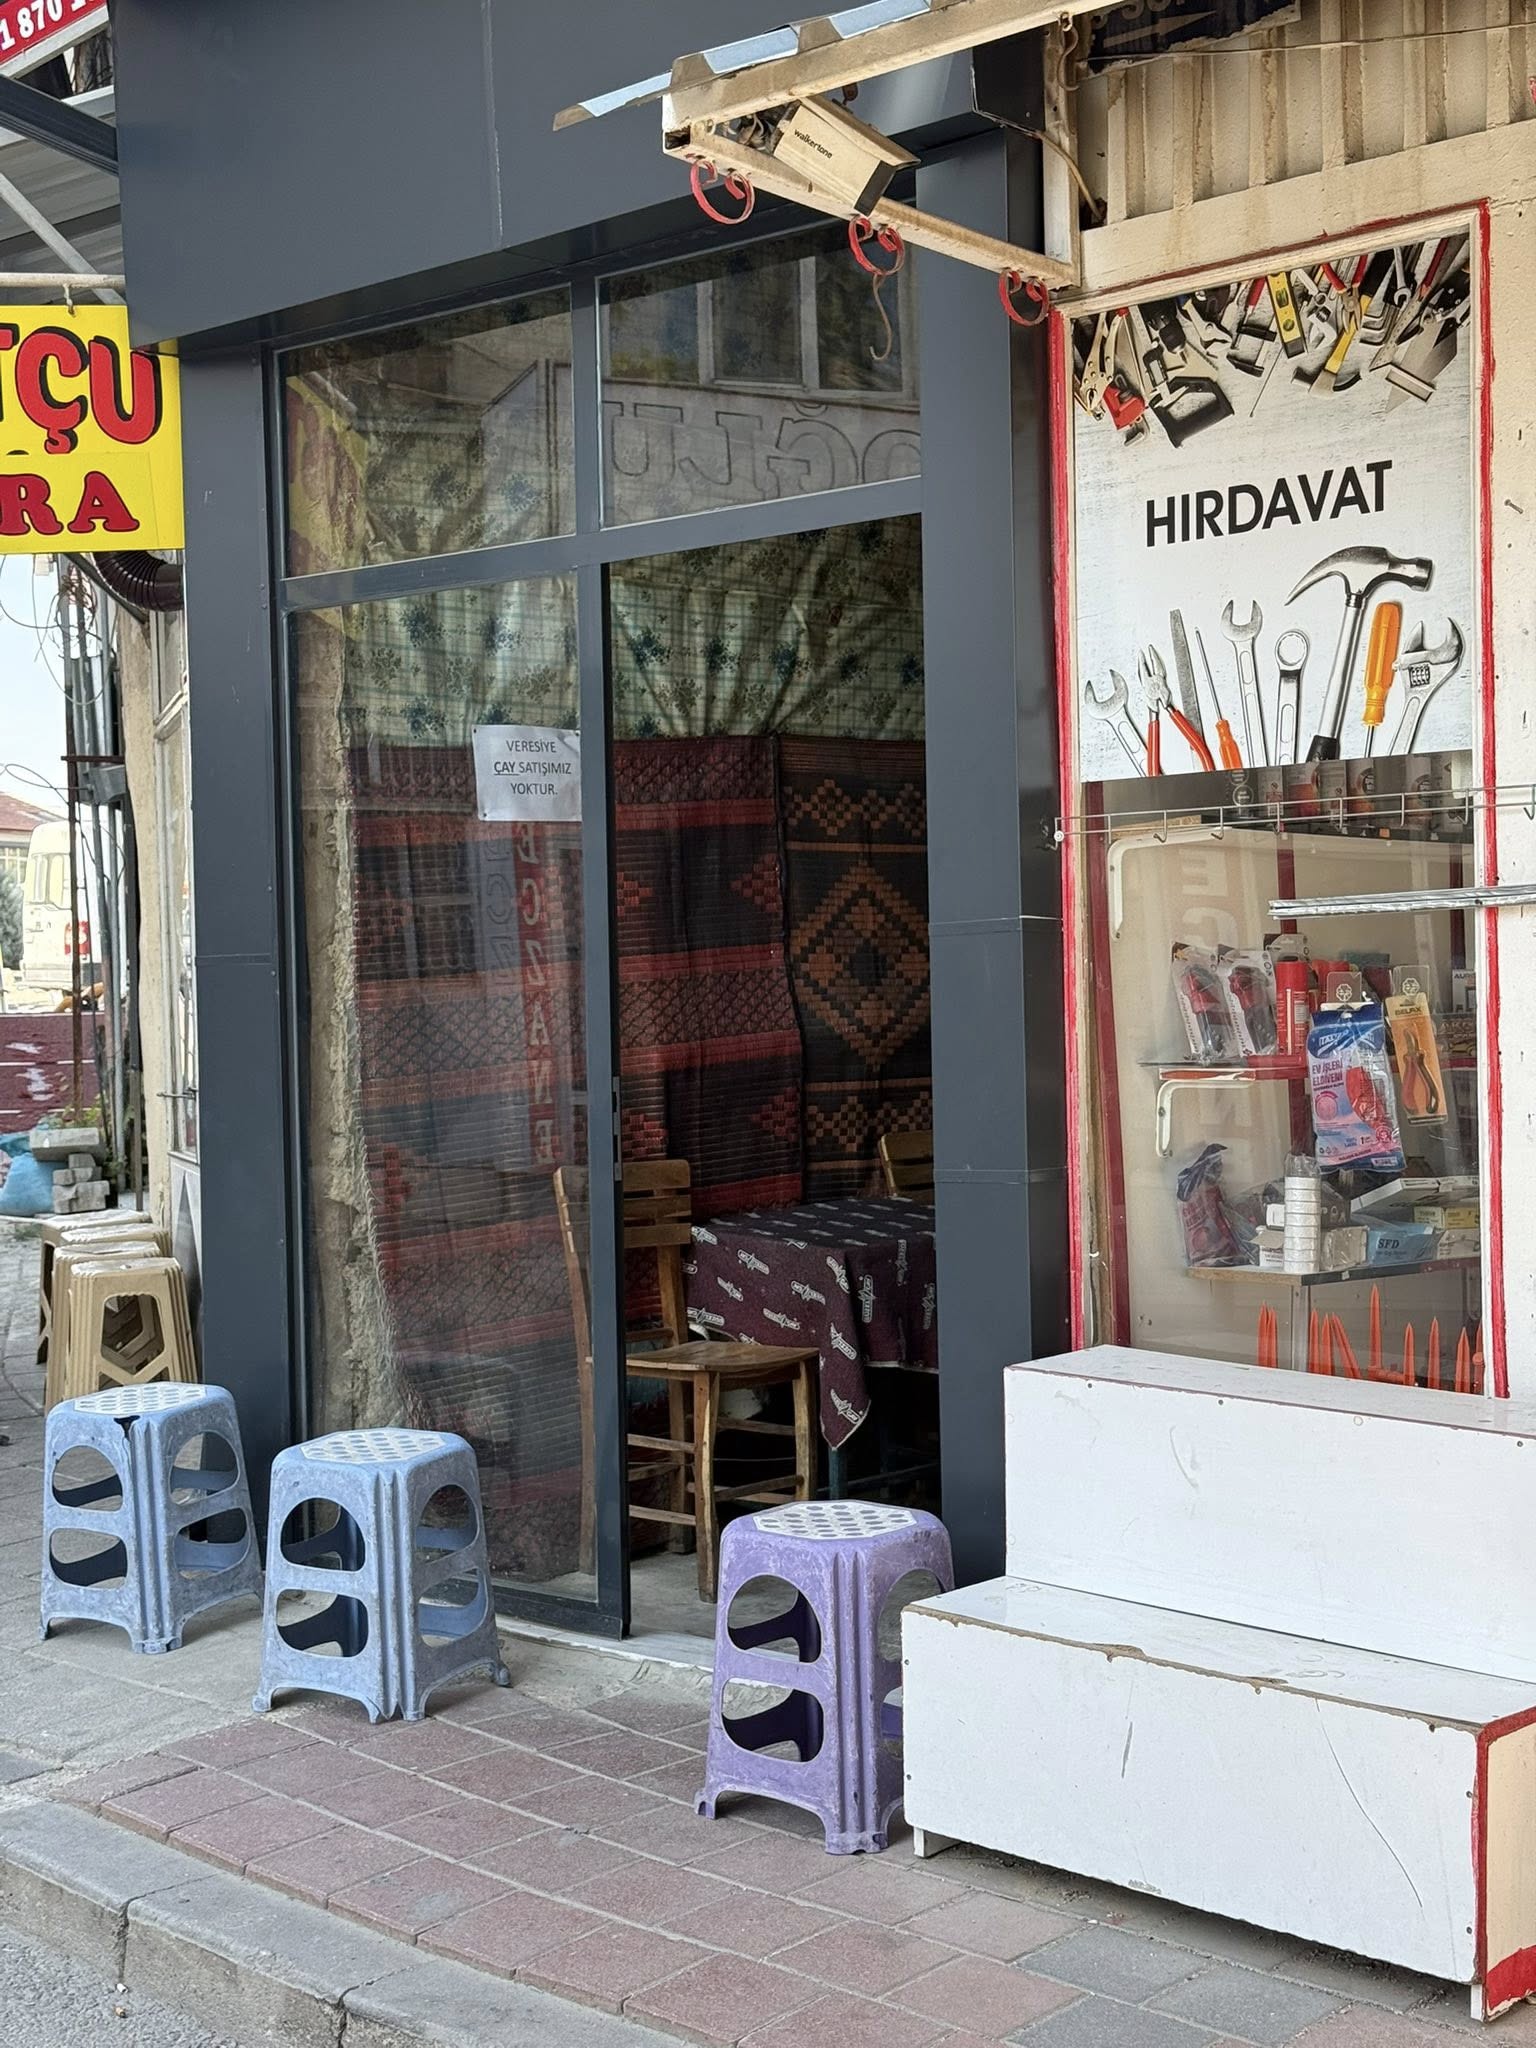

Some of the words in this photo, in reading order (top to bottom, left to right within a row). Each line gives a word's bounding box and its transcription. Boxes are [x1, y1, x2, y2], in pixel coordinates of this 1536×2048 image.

[17, 0, 63, 38] 870
[793, 128, 833, 159] walkertone
[1146, 460, 1393, 548] HIRDAVAT
[506, 739, 557, 753] VERESİYE
[494, 761, 516, 775] ÇAY
[518, 761, 572, 776] SATIŞIMIZ
[510, 783, 558, 795] YOKTUR.
[1377, 1238, 1400, 1249] SFD
